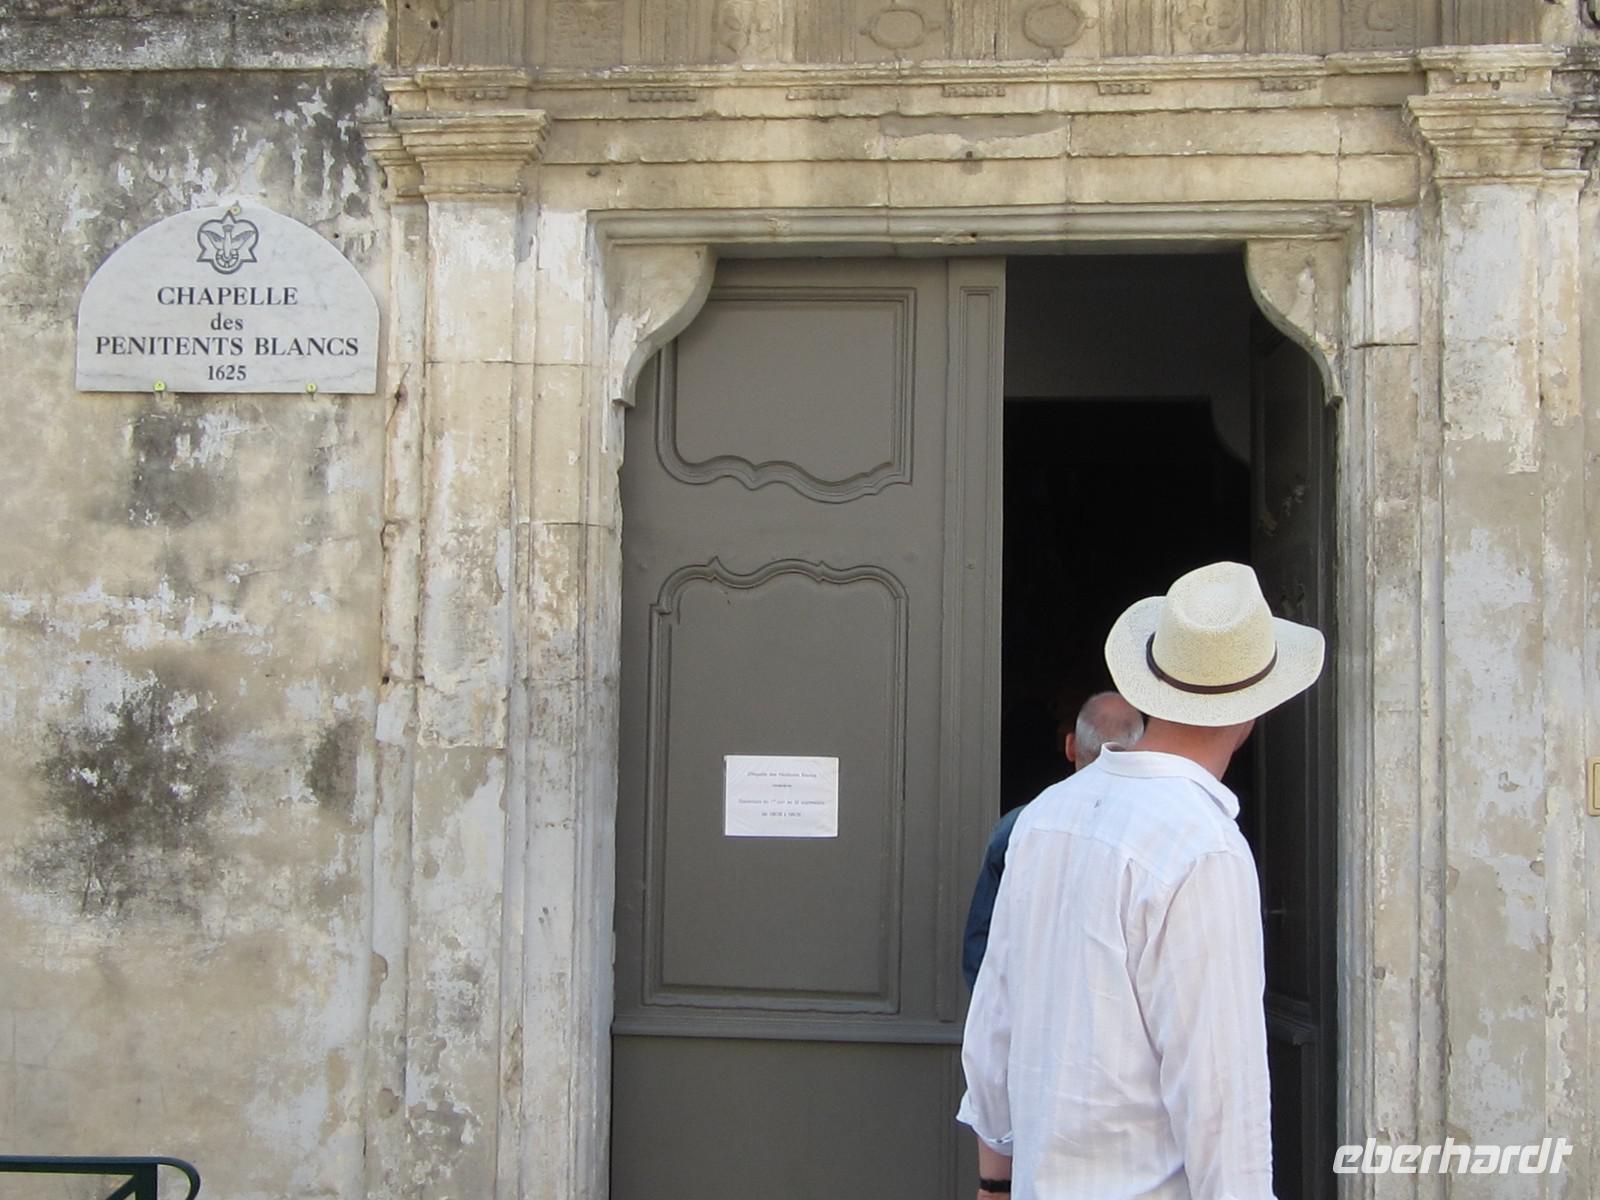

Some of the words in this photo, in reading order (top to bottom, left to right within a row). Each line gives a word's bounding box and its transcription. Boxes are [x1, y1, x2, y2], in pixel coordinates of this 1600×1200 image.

[157, 287, 298, 305] CHAPELLE
[211, 312, 243, 331] des
[96, 336, 243, 356] PENITENTS
[255, 338, 359, 356] BLANCS
[208, 365, 246, 381] 1625
